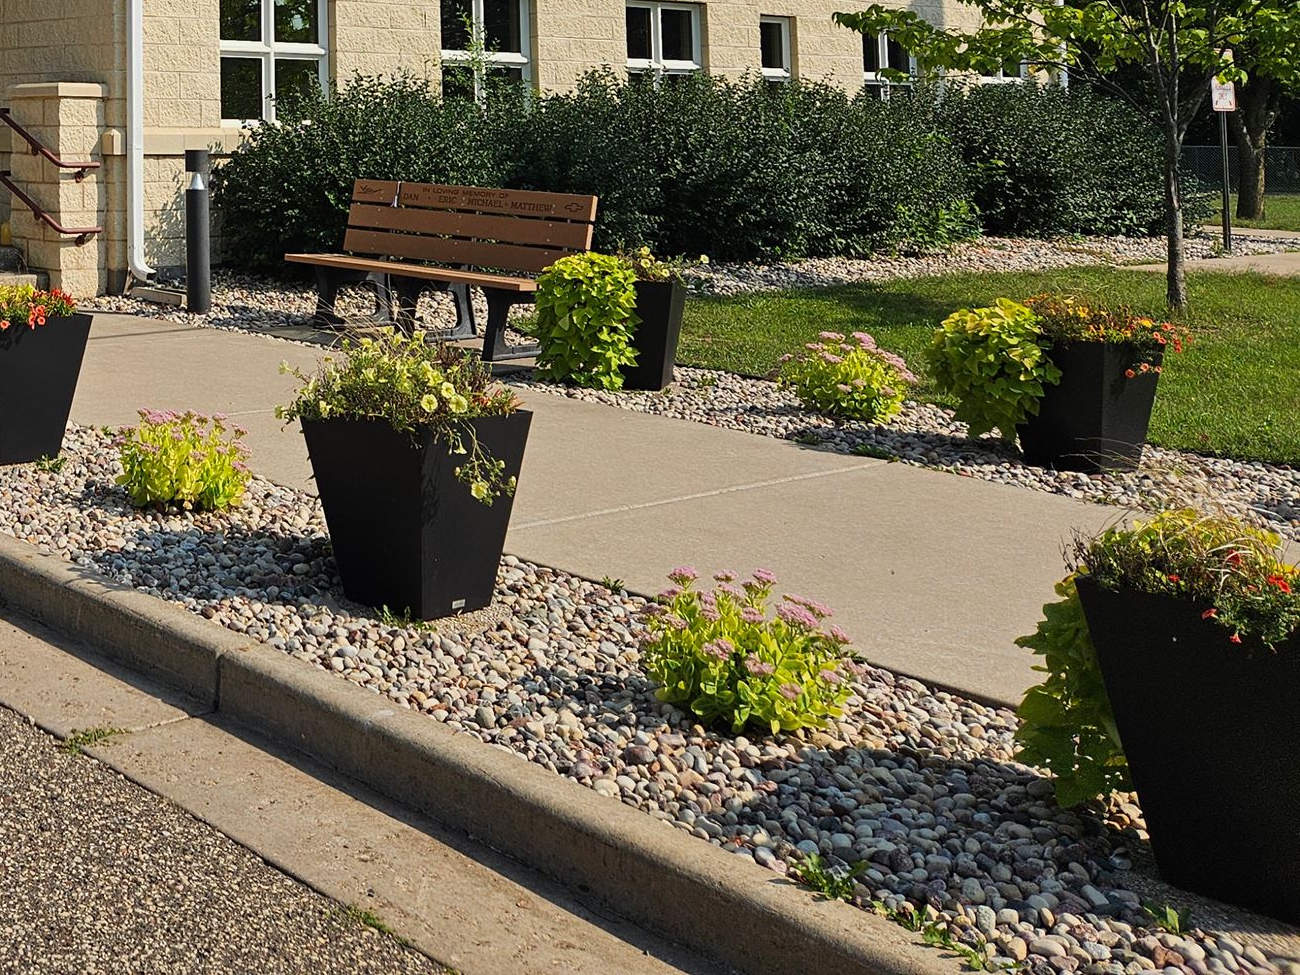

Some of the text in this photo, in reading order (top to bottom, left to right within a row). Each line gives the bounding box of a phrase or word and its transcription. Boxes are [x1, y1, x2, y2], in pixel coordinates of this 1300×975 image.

[462, 190, 497, 198] MEMORY
[403, 193, 552, 213] DAN ERIC MICHAEL MATTHEW
